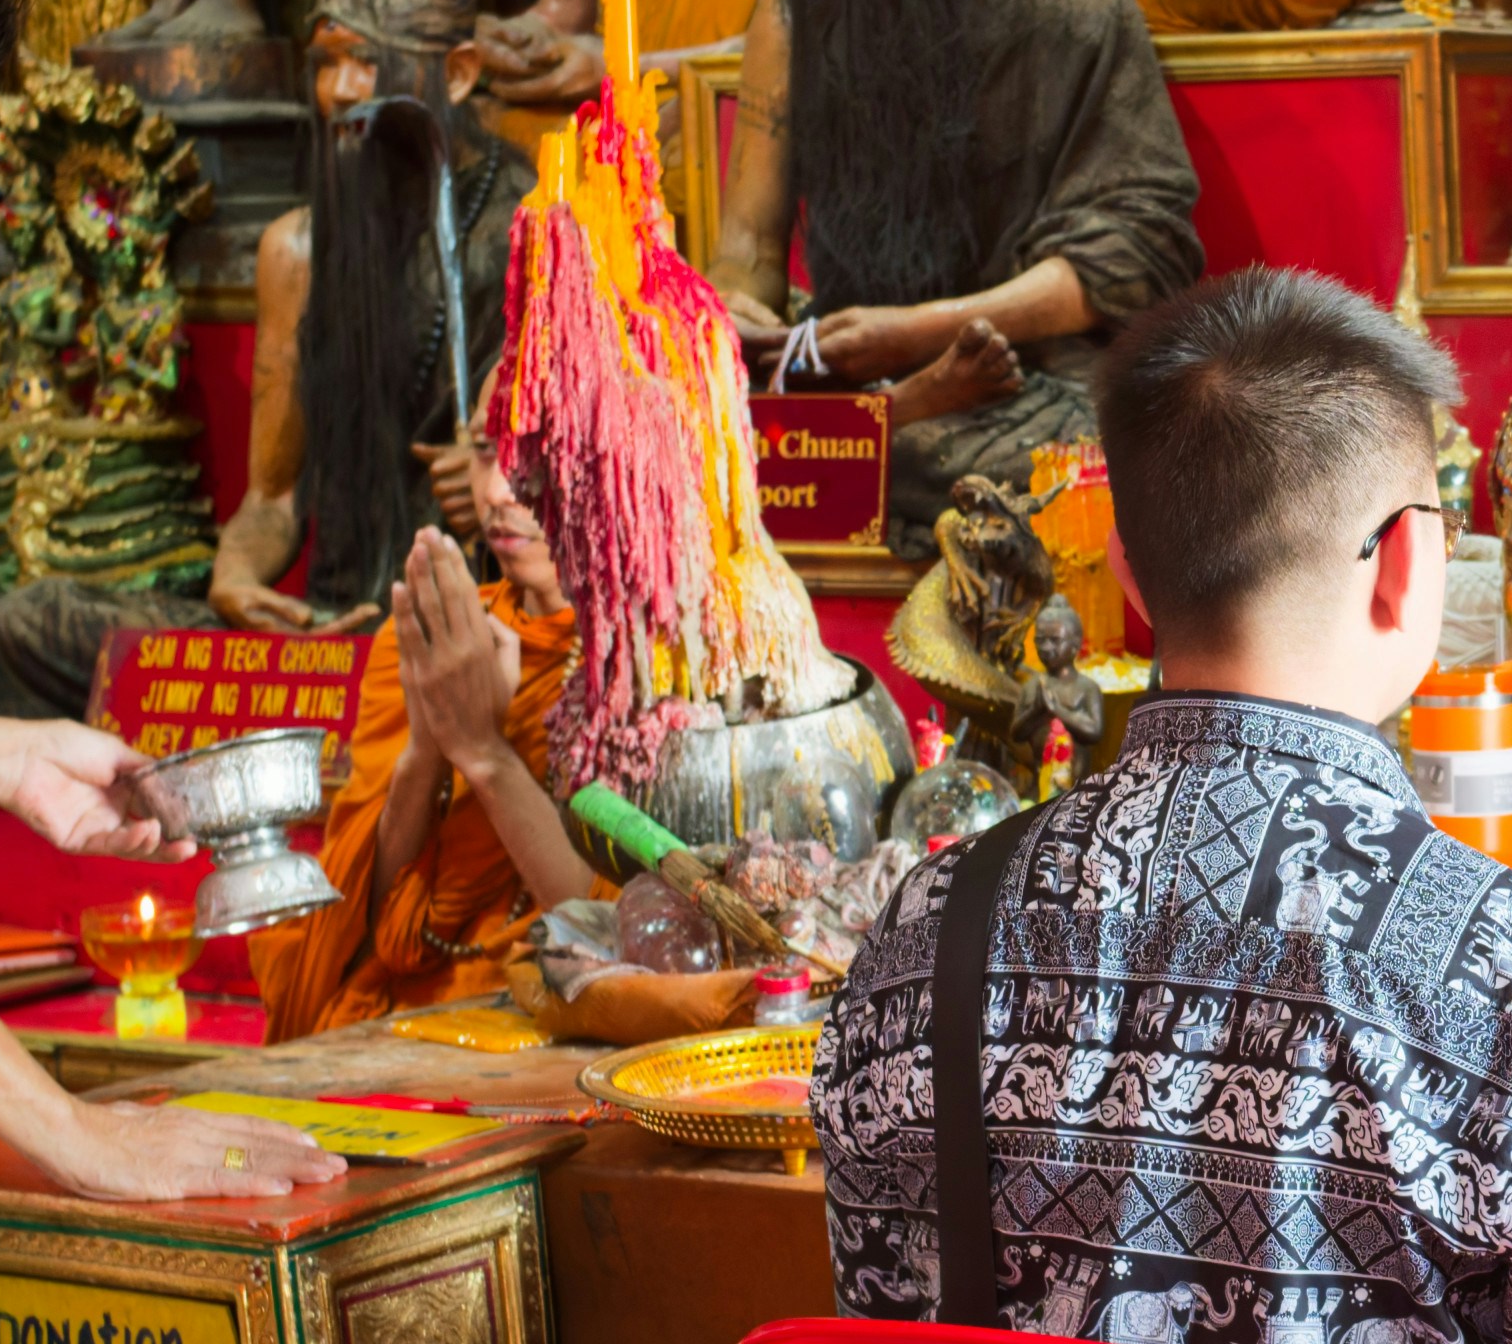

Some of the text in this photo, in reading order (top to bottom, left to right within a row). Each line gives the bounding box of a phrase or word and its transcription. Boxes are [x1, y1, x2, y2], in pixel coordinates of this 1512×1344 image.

[777, 429, 876, 460] Chuan
[758, 483, 818, 508] port
[184, 637, 213, 671] NG
[222, 638, 273, 673] TECK
[278, 640, 355, 675] CHOONG
[141, 680, 205, 714] JIMMY
[211, 682, 240, 716] NG
[294, 685, 347, 720] MING
